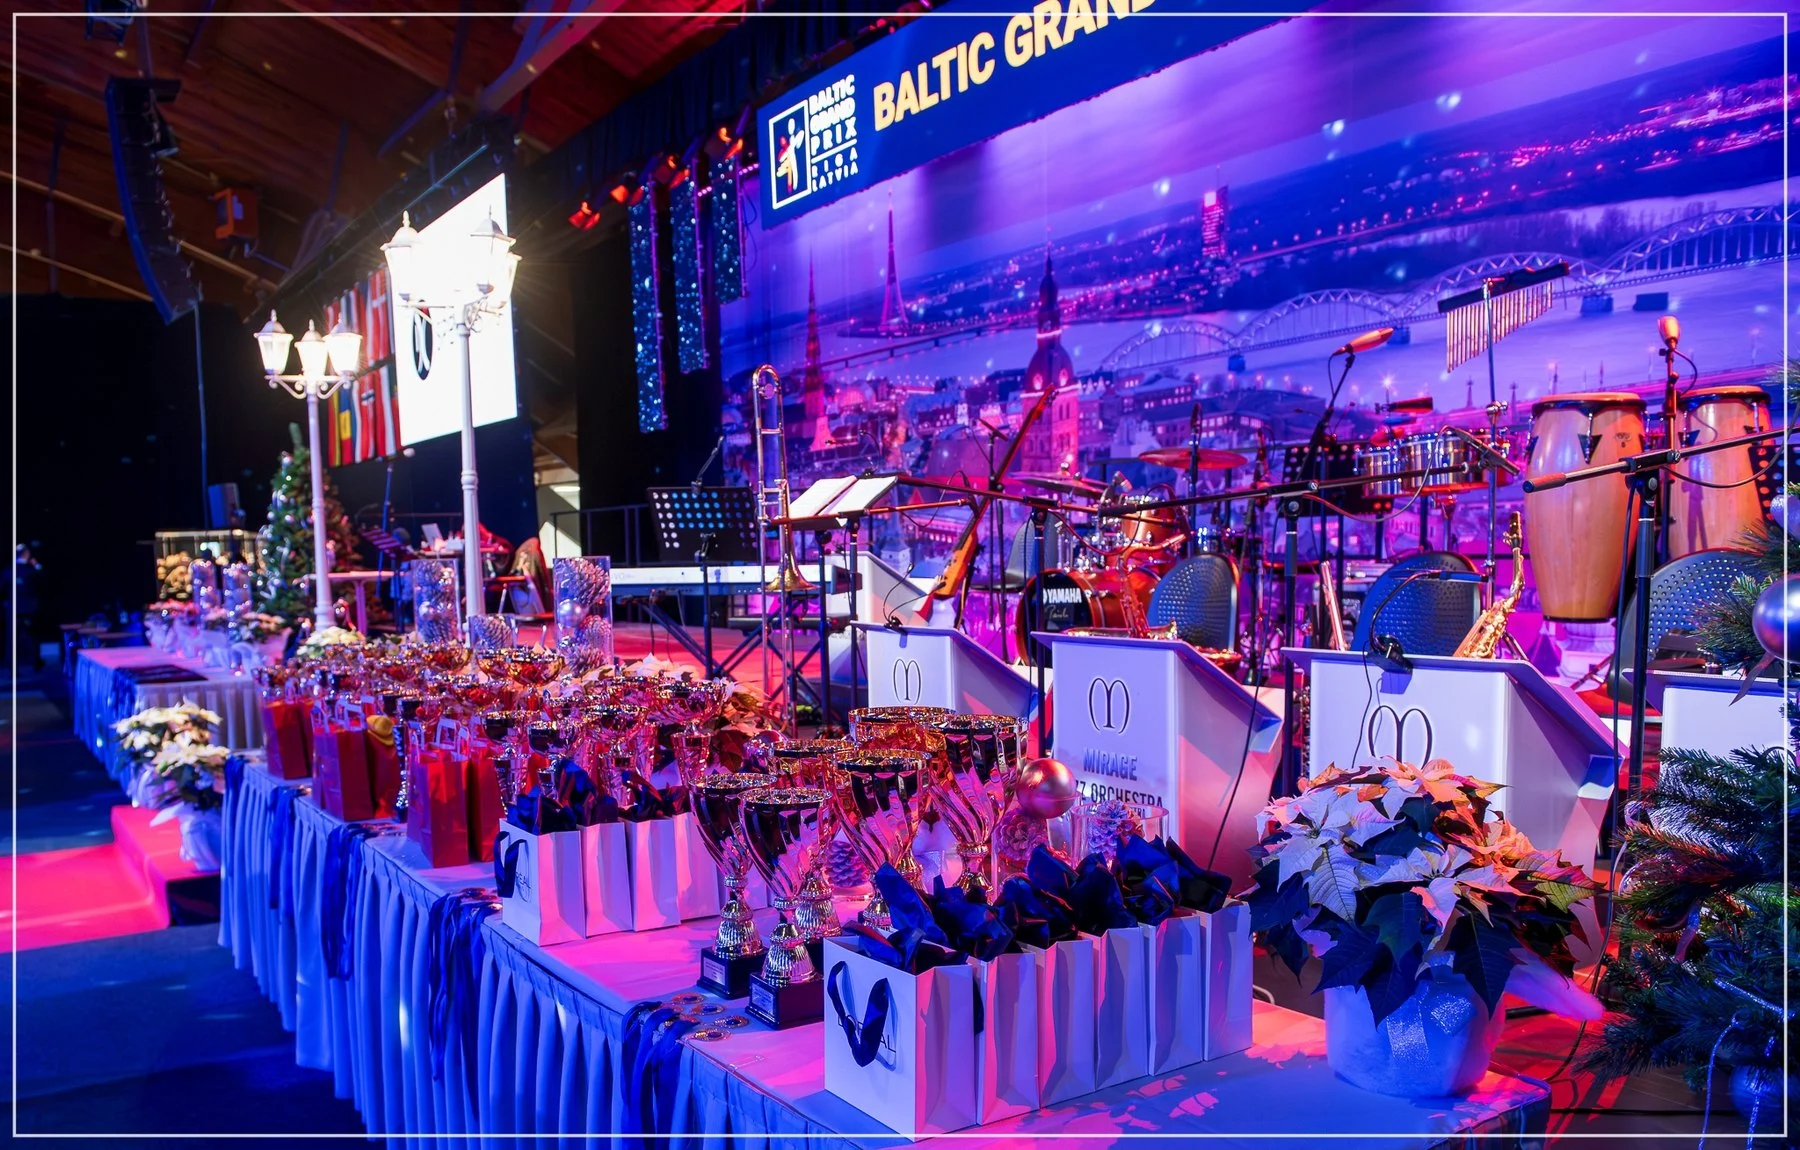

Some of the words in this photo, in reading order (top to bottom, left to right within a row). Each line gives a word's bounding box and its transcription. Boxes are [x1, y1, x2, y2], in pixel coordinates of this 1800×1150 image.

[873, 31, 996, 132] BALTIC
[1004, 0, 1156, 68] GRAN
[808, 74, 855, 116] BALTIC
[809, 97, 856, 135] GRAND
[810, 116, 857, 156] PRIX
[811, 147, 858, 178] RIGA
[811, 161, 859, 192] LATVIA
[1046, 587, 1083, 604] YAMAHA
[1082, 747, 1138, 782] MIRAGE
[1090, 782, 1164, 808] ORCHESTRA
